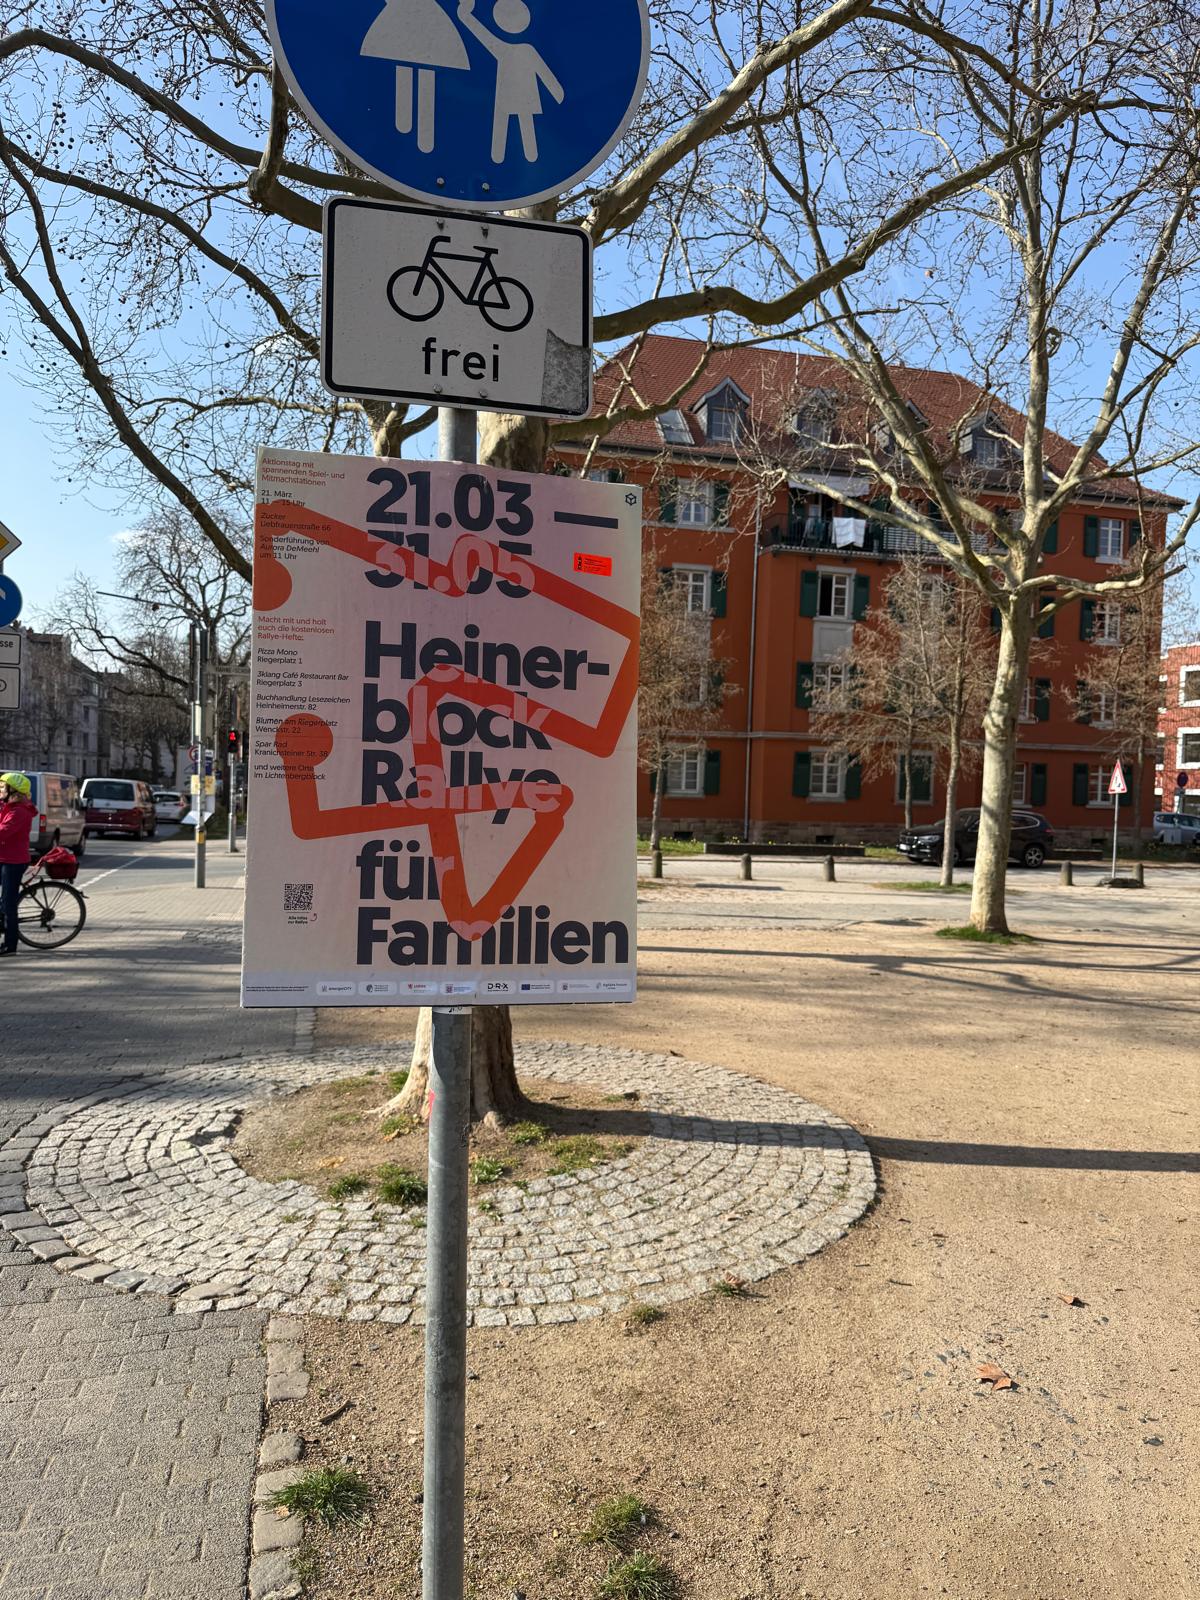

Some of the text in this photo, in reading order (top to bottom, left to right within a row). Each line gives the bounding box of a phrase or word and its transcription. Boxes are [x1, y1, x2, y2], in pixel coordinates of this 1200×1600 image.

[422, 337, 499, 382] frei
[262, 458, 300, 468] Aktionstag
[262, 466, 306, 476] spannenden
[262, 475, 326, 486] Mitmachstationen
[274, 490, 292, 498] März
[366, 467, 534, 536] 21.03
[260, 521, 320, 531] Liebfrauenstraße
[260, 535, 314, 545] Sonderführung
[364, 529, 536, 598] 31.05
[364, 620, 610, 690] Heiner-
[257, 656, 296, 665] Riegerplatz
[257, 670, 281, 679] 3klang
[256, 679, 296, 687] Riegerplatz
[256, 694, 351, 704] Buchhandlung Lesezeichen
[362, 683, 552, 750] block
[298, 719, 338, 727] Riegerplatz
[265, 772, 326, 780] Lichtenbergblock
[361, 749, 562, 824] Rallye
[356, 840, 454, 900] für
[356, 904, 629, 966] Familien
